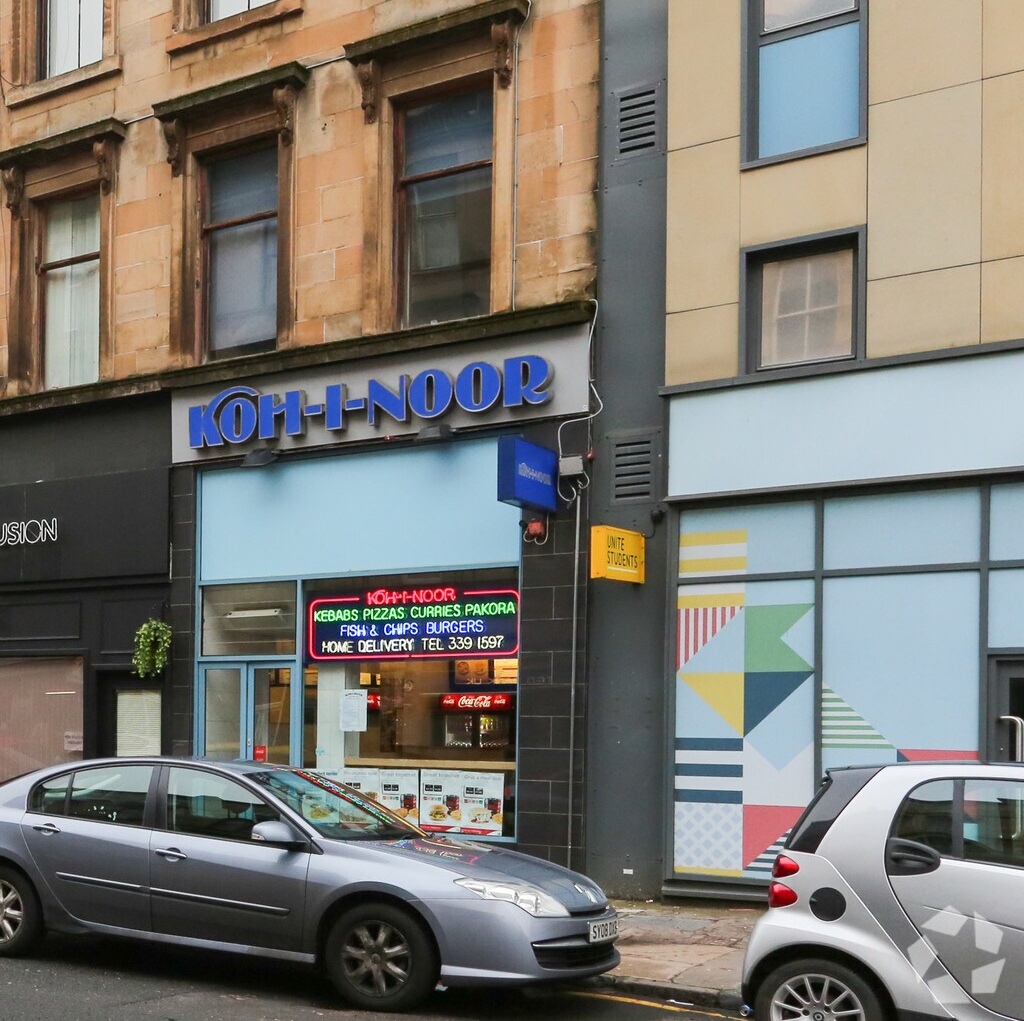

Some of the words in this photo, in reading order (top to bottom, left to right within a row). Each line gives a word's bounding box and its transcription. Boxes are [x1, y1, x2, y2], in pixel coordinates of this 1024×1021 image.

[188, 355, 552, 449] KOH-I-NOOR
[607, 535, 625, 551] UNITE
[606, 551, 638, 569] STUDENTS
[368, 588, 456, 605] KOH-I-NOOR
[314, 609, 358, 622] KEBABS
[363, 607, 405, 620] PIZZAS
[410, 604, 461, 618] CURRIES
[465, 601, 516, 616] PAKORA
[340, 625, 366, 637] FISH
[370, 624, 379, 636] &
[384, 622, 418, 635] CHIPS
[426, 620, 484, 634] BURGERS
[322, 640, 354, 653] HOME
[358, 638, 415, 652] DELIVERY
[422, 638, 444, 651] TEL
[448, 636, 473, 650] 339
[477, 635, 504, 649] 1597
[458, 695, 492, 708] Coca-Cola
[592, 923, 608, 940] SY08
